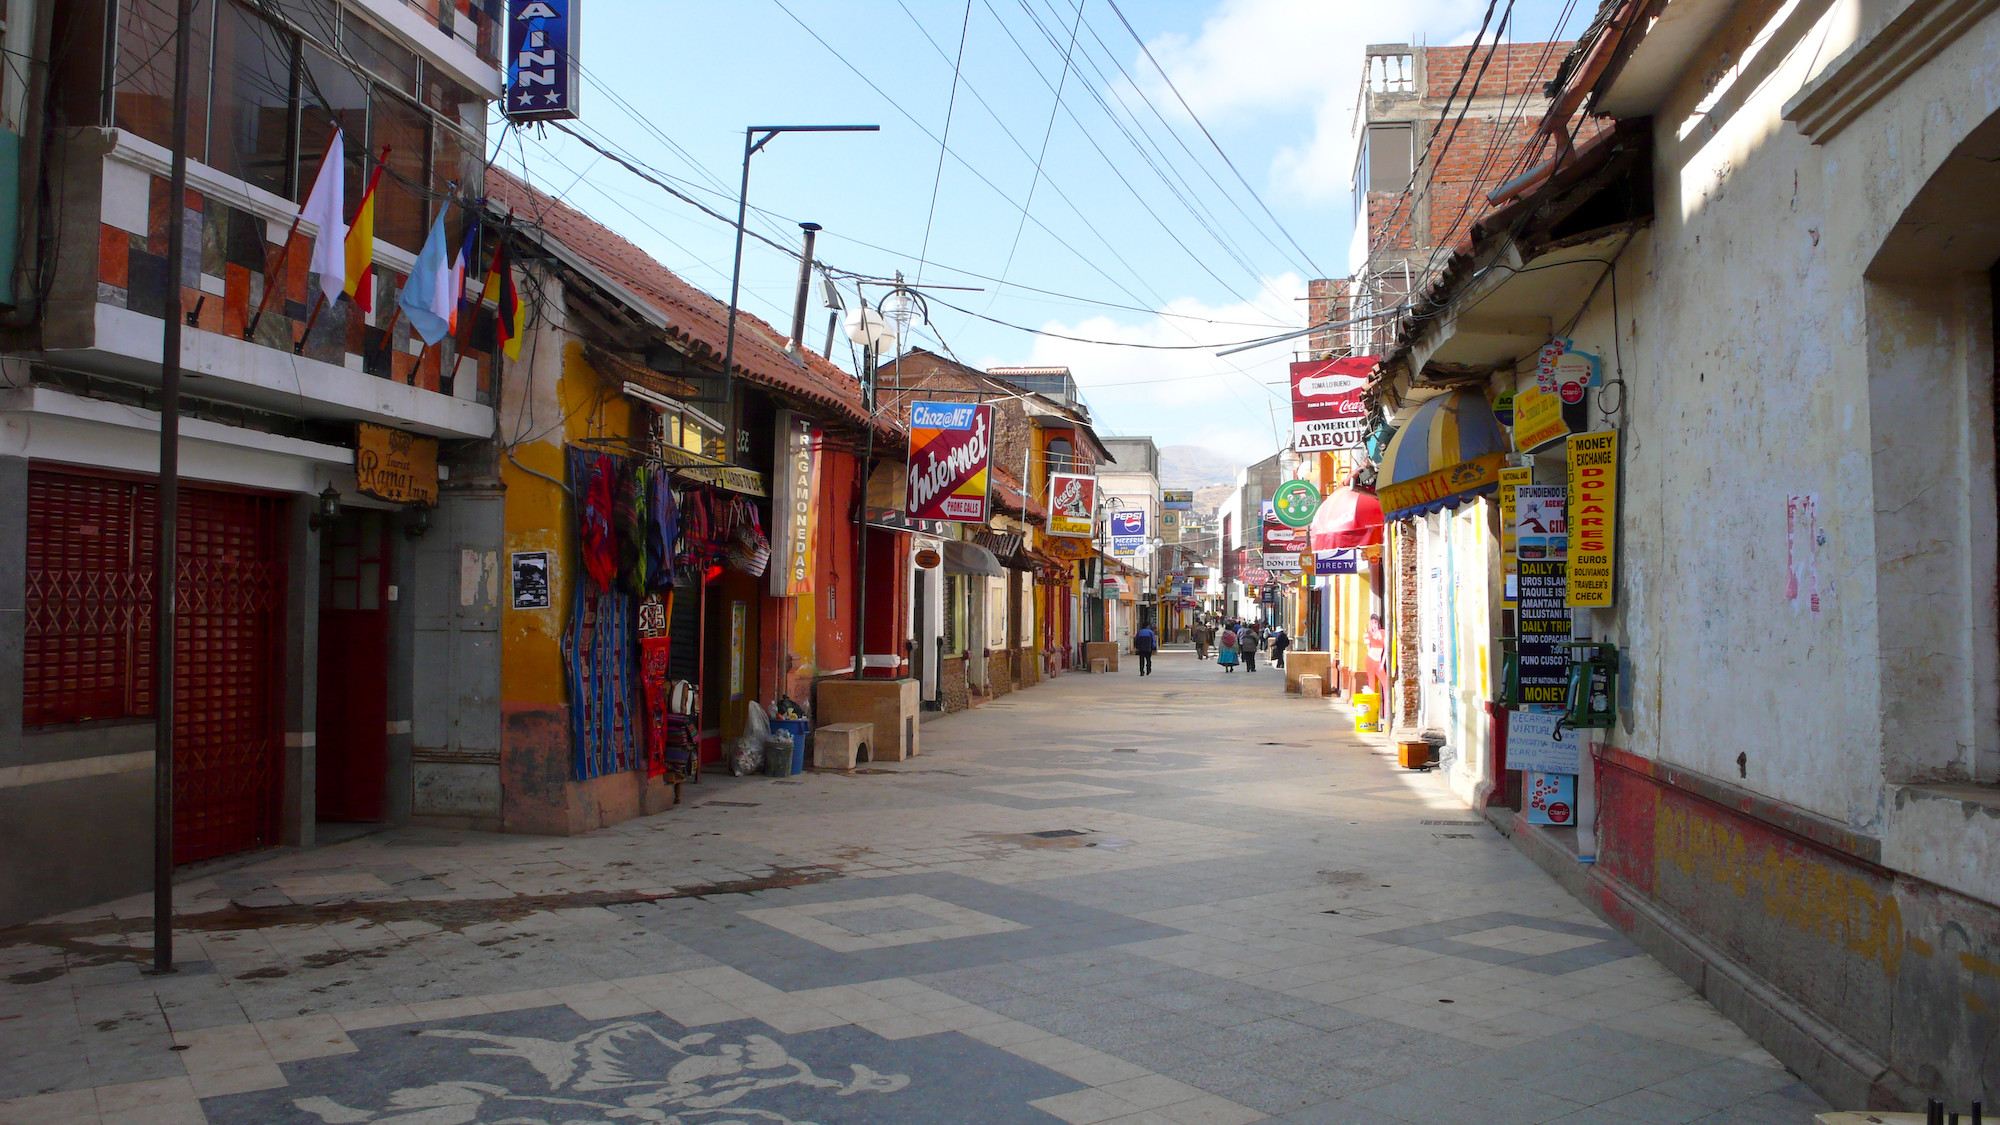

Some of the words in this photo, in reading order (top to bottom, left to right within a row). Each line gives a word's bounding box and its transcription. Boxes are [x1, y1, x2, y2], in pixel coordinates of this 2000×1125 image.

[1334, 380, 1351, 388] BUENO
[913, 406, 974, 428] Choz@NET
[1576, 437, 1613, 451] MONEY
[910, 413, 987, 513] Internet
[1577, 451, 1612, 466] EXCHANGE
[1519, 487, 1560, 498] DIFUNDIENDO
[796, 420, 811, 581] TRAGAMONEDAS
[1580, 468, 1605, 551] DOLARES
[1113, 512, 1142, 520] PEPSI
[1578, 556, 1607, 564] EUROS
[1521, 563, 1553, 575] DAILY
[1574, 568, 1609, 577] BOLIVIANOS
[1521, 577, 1542, 587] UROS
[1574, 579, 1608, 590] TRAVELER'S
[1521, 588, 1554, 597] TAQUILE
[1575, 592, 1603, 601] CHECK
[1521, 599, 1560, 609] AMANTANI
[1521, 609, 1562, 619] SILLUSTANI
[1521, 621, 1548, 632] DAILY
[1521, 635, 1539, 644] PUNO
[1520, 656, 1540, 666] PUNO
[1540, 656, 1563, 666] CUSCO
[1521, 677, 1532, 685] SALE
[1525, 687, 1566, 702] MONEY
[1512, 713, 1552, 725] RECARGA
[1513, 724, 1551, 736] VIRTUAL
[1549, 808, 1568, 816] Claro
